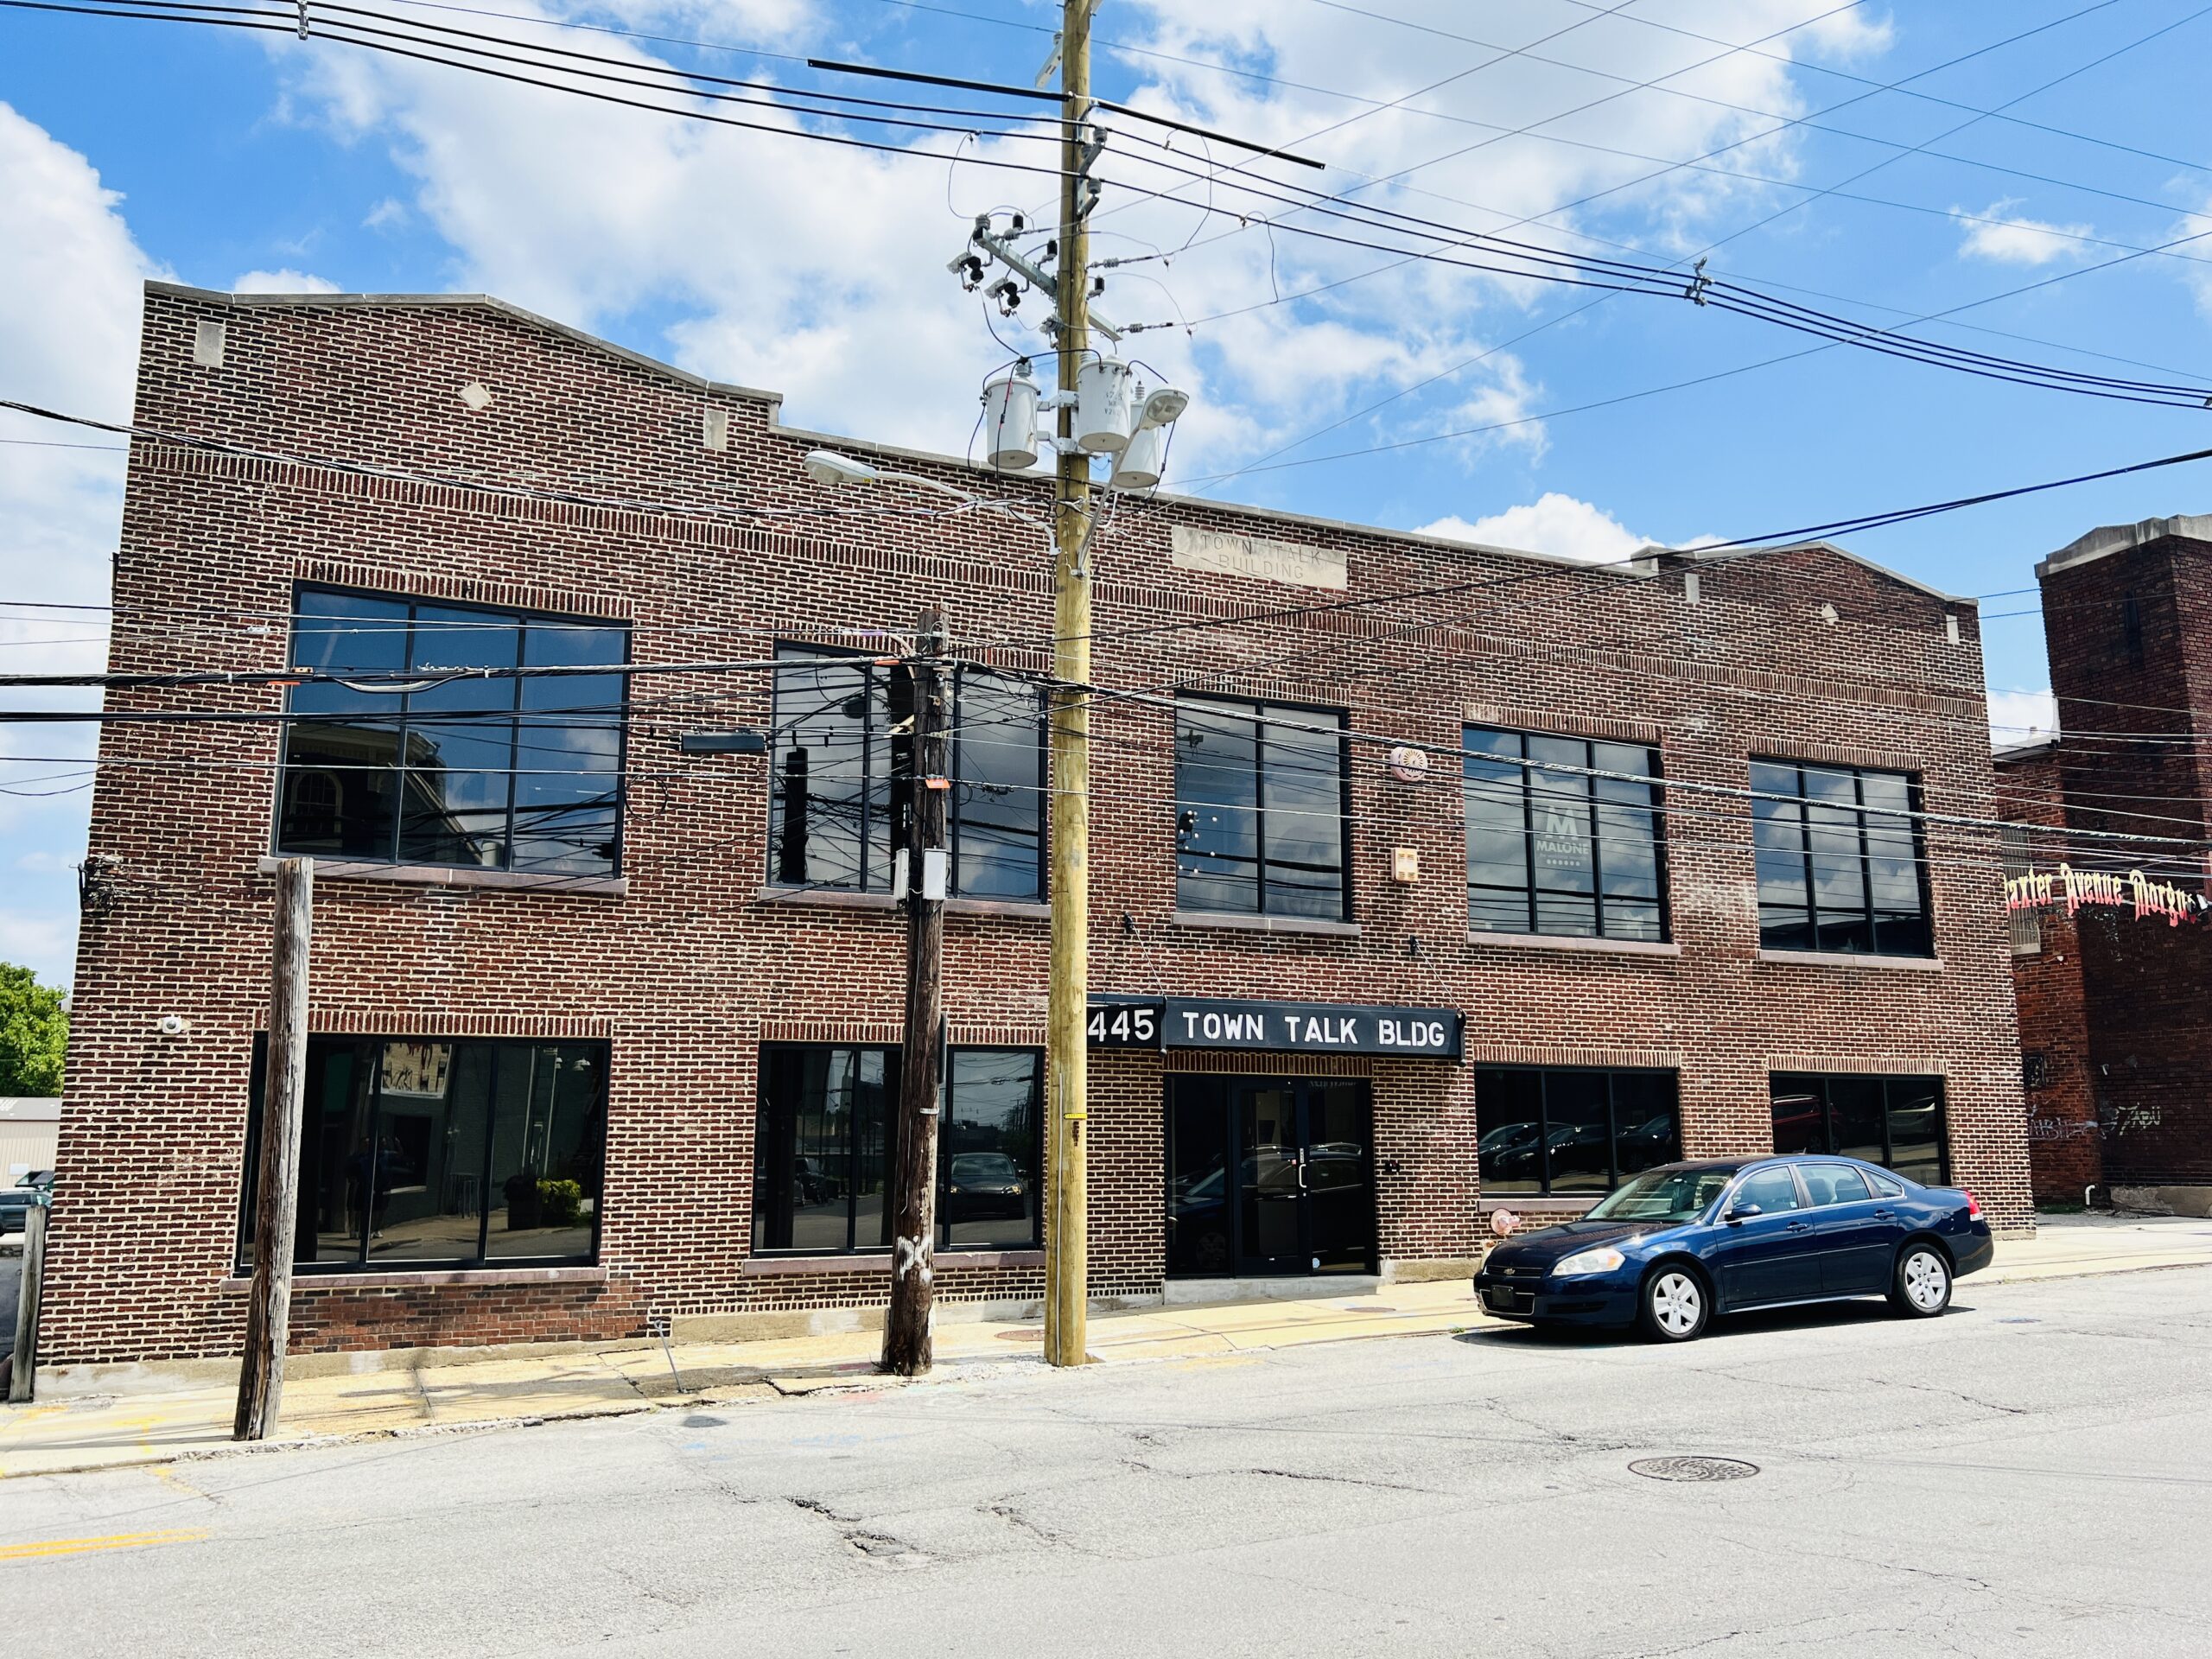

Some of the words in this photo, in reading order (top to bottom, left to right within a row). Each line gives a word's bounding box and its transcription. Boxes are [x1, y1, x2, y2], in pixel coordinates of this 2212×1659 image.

[1202, 535, 1252, 555] TOWN
[1273, 544, 1323, 565] TALK
[1218, 555, 1305, 579] BUILDING
[1536, 841, 1589, 854] MALONE
[2005, 863, 2053, 916] axter
[2060, 862, 2124, 918] Avenue
[1087, 1009, 1154, 1042] 445
[1182, 1011, 1264, 1040] TOWN
[1284, 1015, 1358, 1045] TALK
[1378, 1020, 1446, 1047] BLDG
